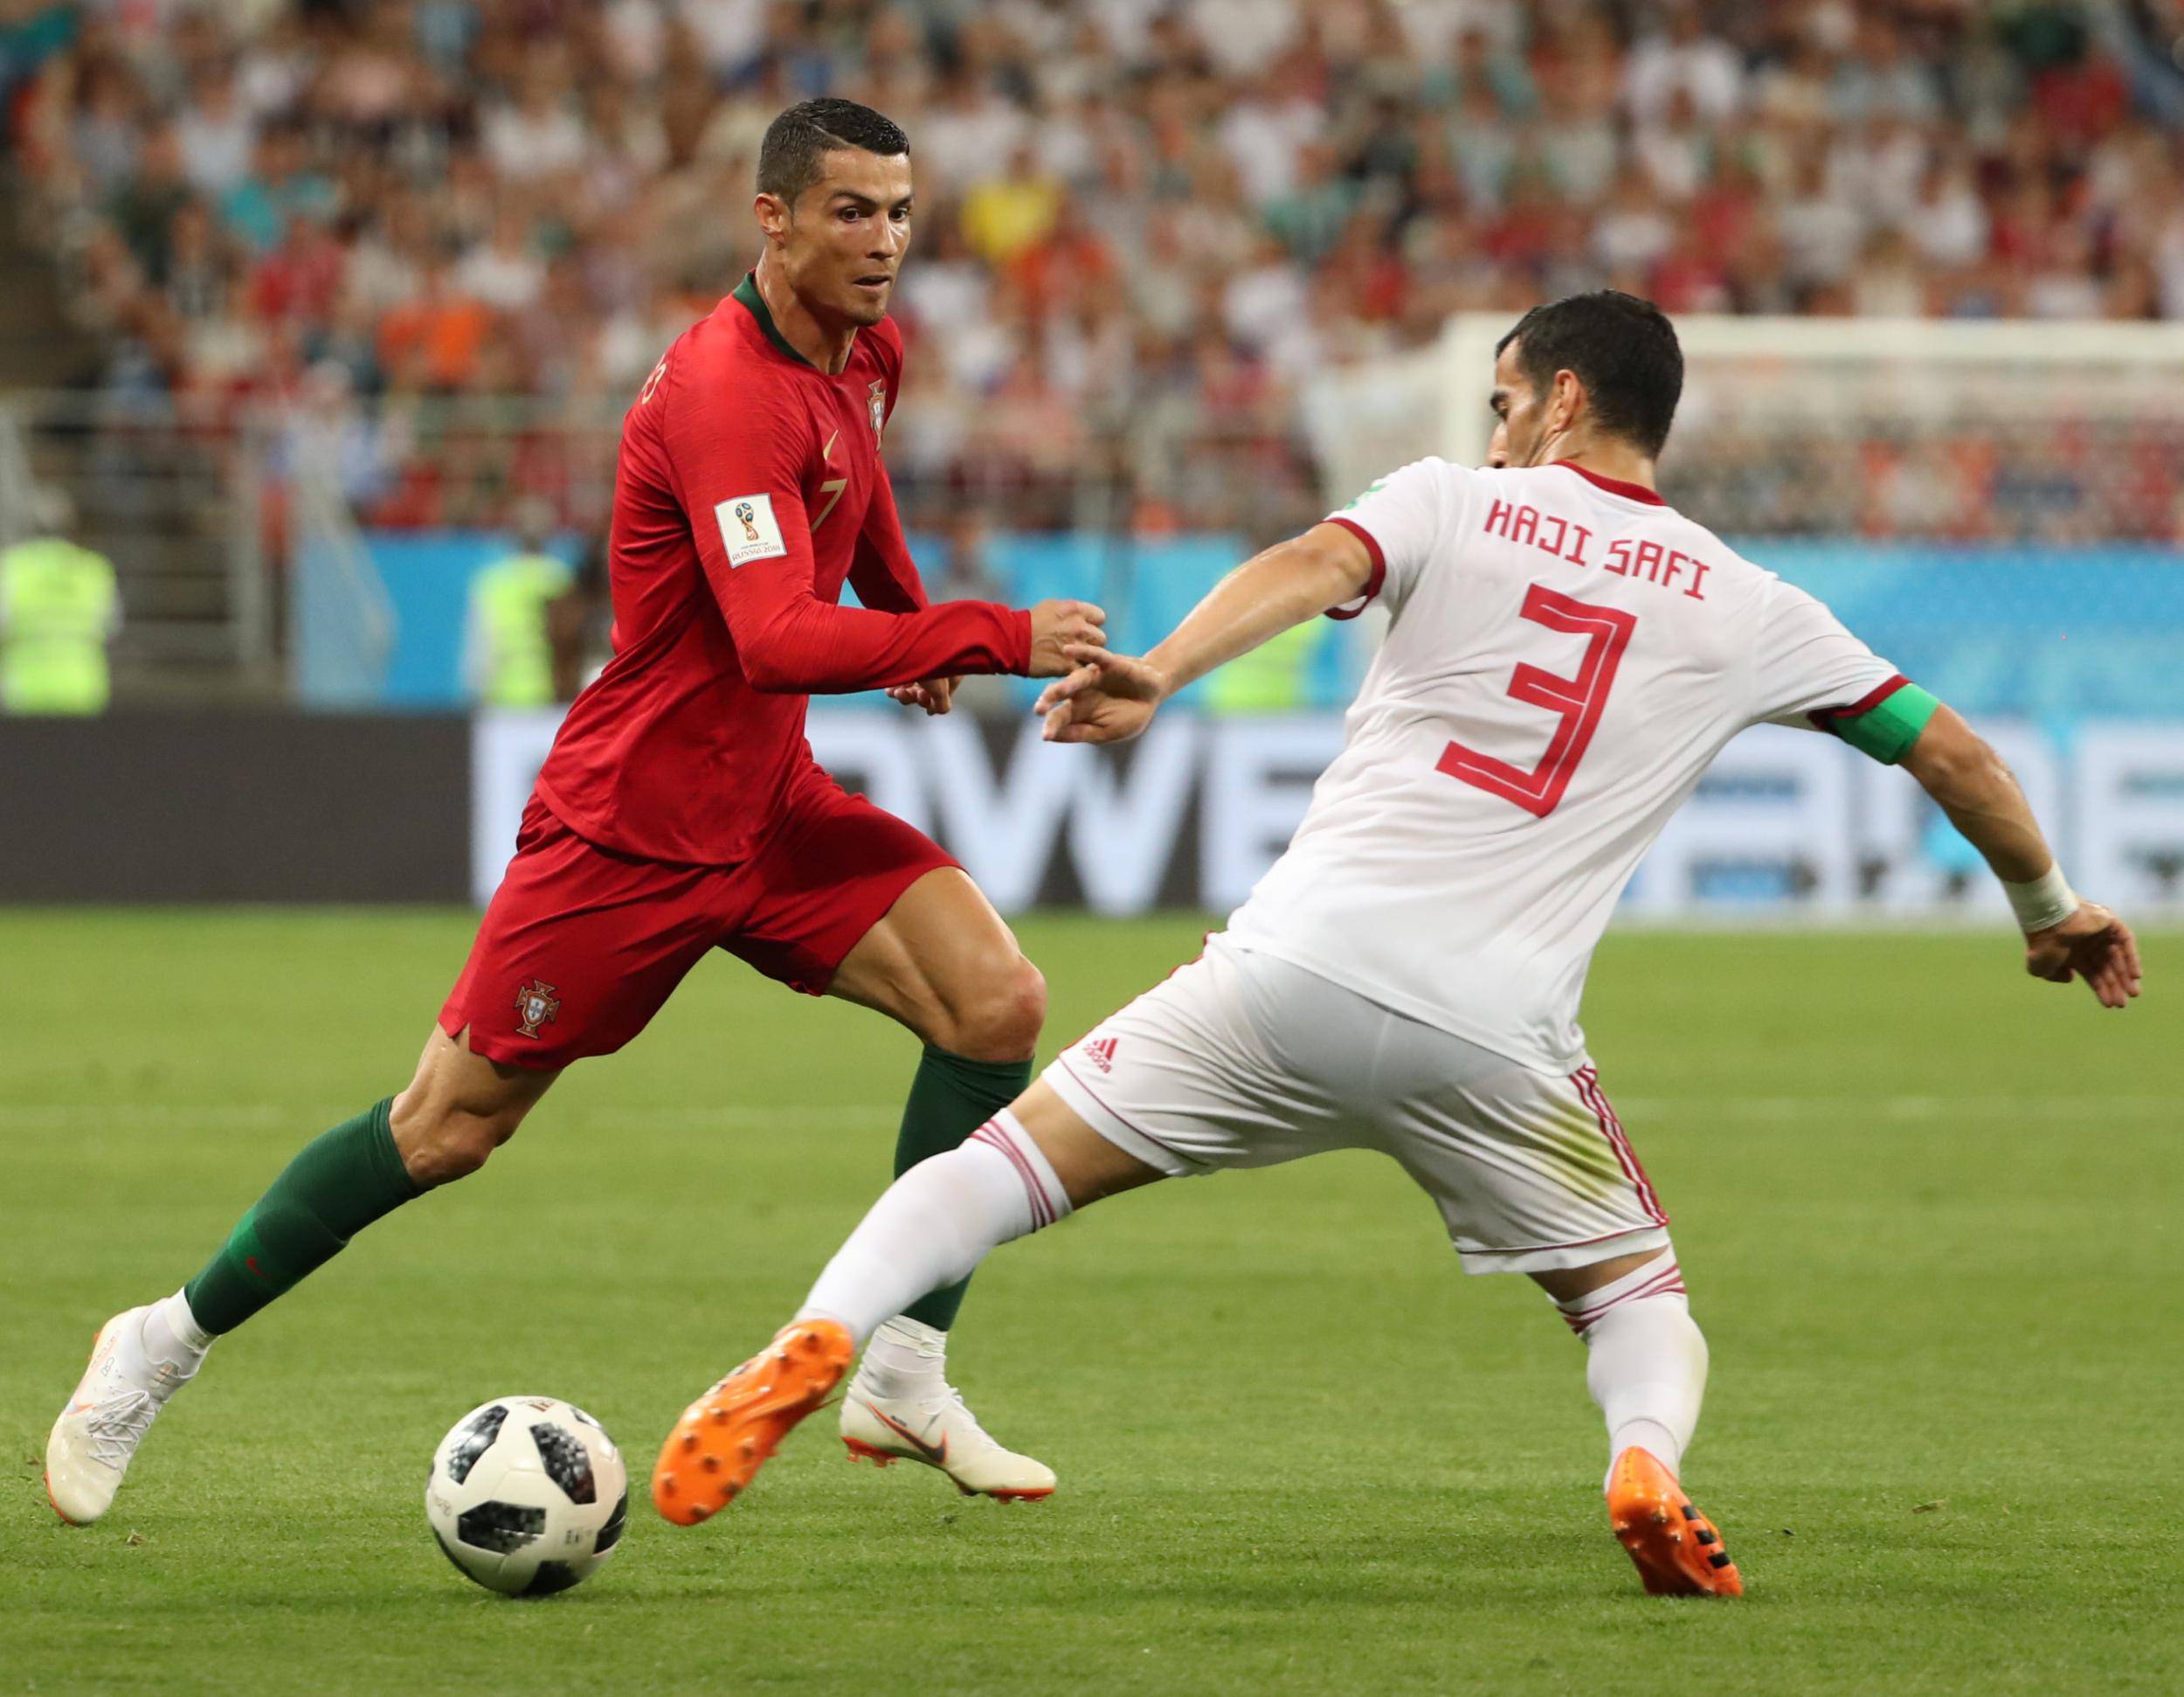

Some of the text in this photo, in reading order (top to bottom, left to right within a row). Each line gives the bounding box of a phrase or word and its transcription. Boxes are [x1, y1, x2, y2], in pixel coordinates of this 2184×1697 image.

[811, 479, 848, 533] 7
[1483, 499, 1711, 601] HAJI SAFI
[1434, 583, 1638, 819] 3
